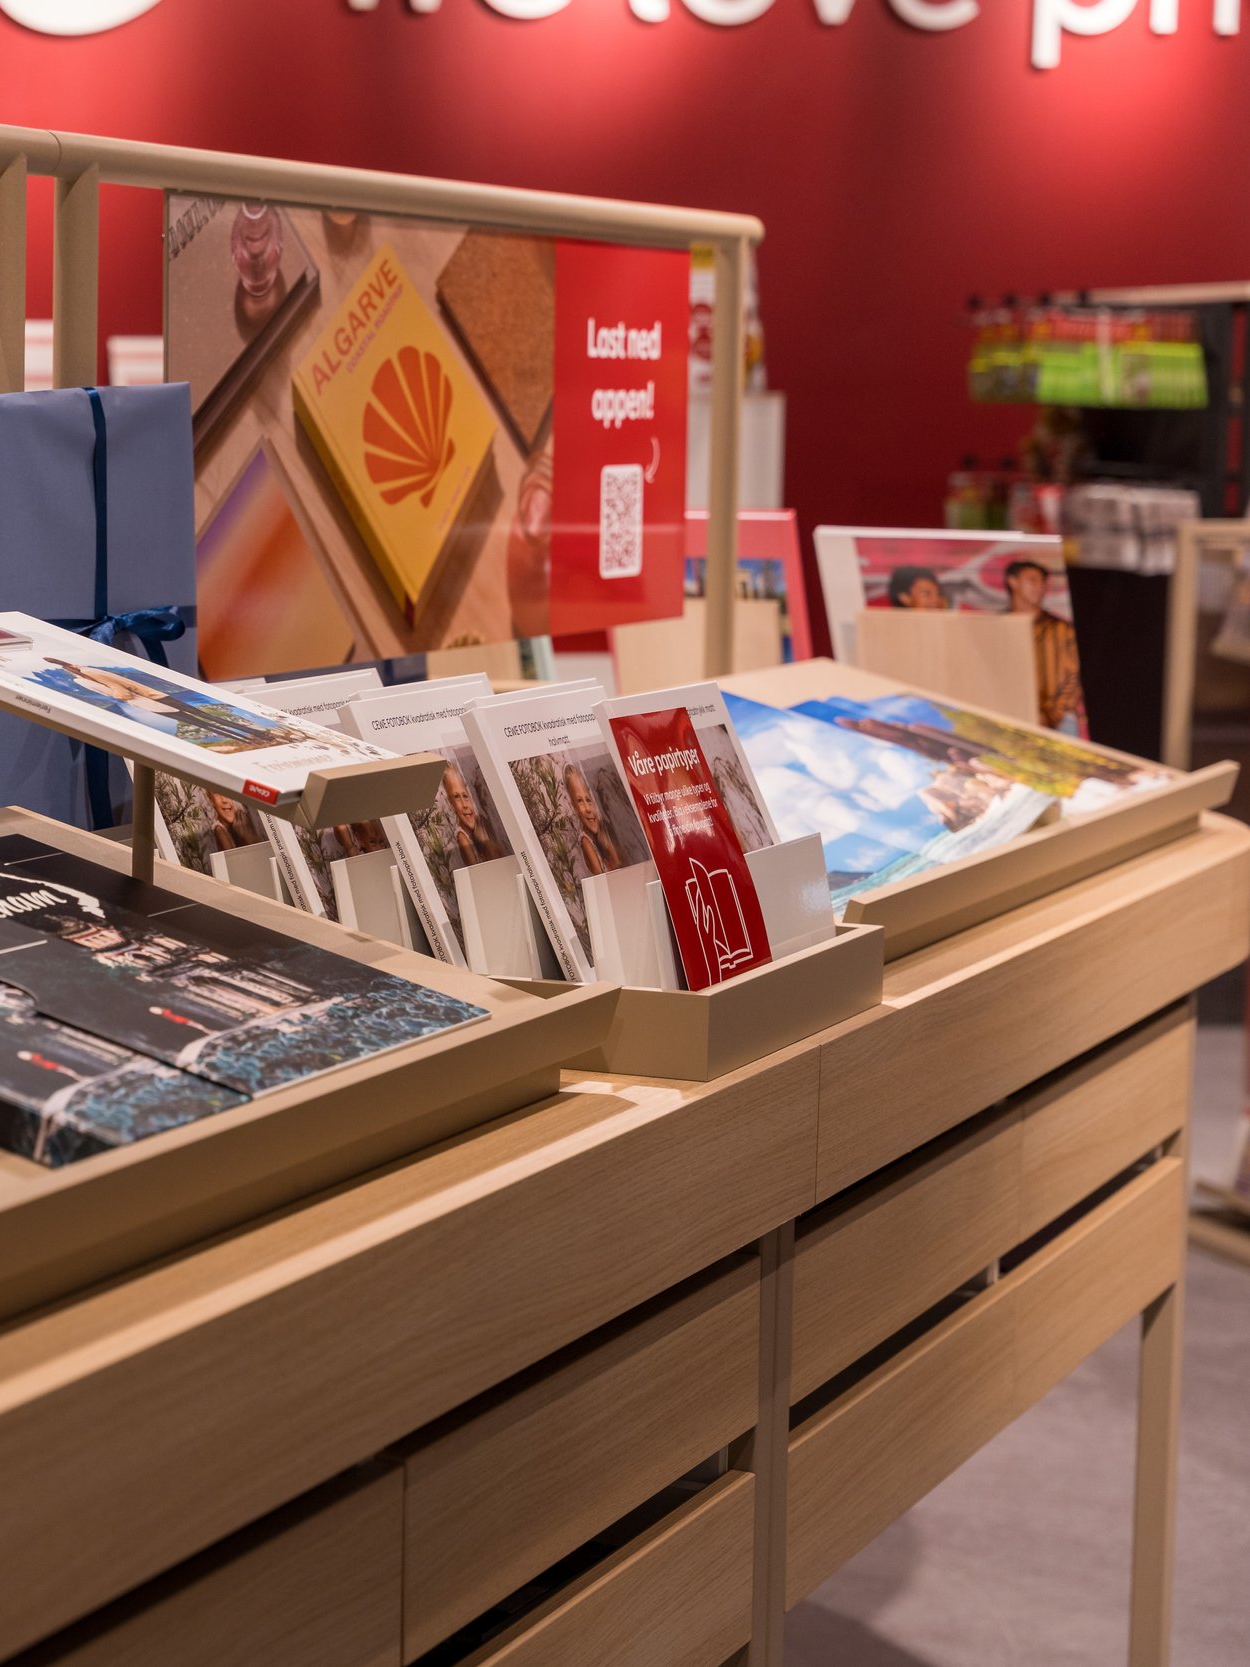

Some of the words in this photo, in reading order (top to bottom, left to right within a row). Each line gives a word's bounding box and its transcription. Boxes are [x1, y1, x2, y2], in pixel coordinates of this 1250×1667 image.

[311, 258, 398, 396] ALGARVE
[587, 316, 626, 359] Last
[627, 320, 662, 361] ned
[591, 380, 655, 429] appen!
[371, 719, 389, 731] CEWE
[386, 714, 411, 729] FOTOBOK
[410, 710, 436, 725] kvadratisk
[435, 710, 447, 720] med
[503, 727, 521, 738] CEWE
[518, 721, 543, 737] FOTOBOK
[541, 717, 567, 731] kvadratisk
[565, 716, 578, 725] med
[548, 735, 571, 747] halvmatt
[627, 750, 656, 777] Våre
[653, 746, 701, 776] papirtyper
[663, 789, 682, 801] mange
[681, 784, 693, 797] ulike
[691, 783, 705, 797] typer
[269, 823, 284, 851] premium
[394, 840, 407, 860] blank
[280, 850, 296, 881] fotopapir
[400, 859, 420, 889] fotopapir
[519, 850, 536, 878] halvmatt
[291, 880, 301, 896] med
[413, 889, 424, 904] med
[529, 877, 548, 906] fotopapir
[419, 904, 439, 938] kvadratisk
[541, 905, 552, 920] med
[546, 919, 566, 951] kvadratisk
